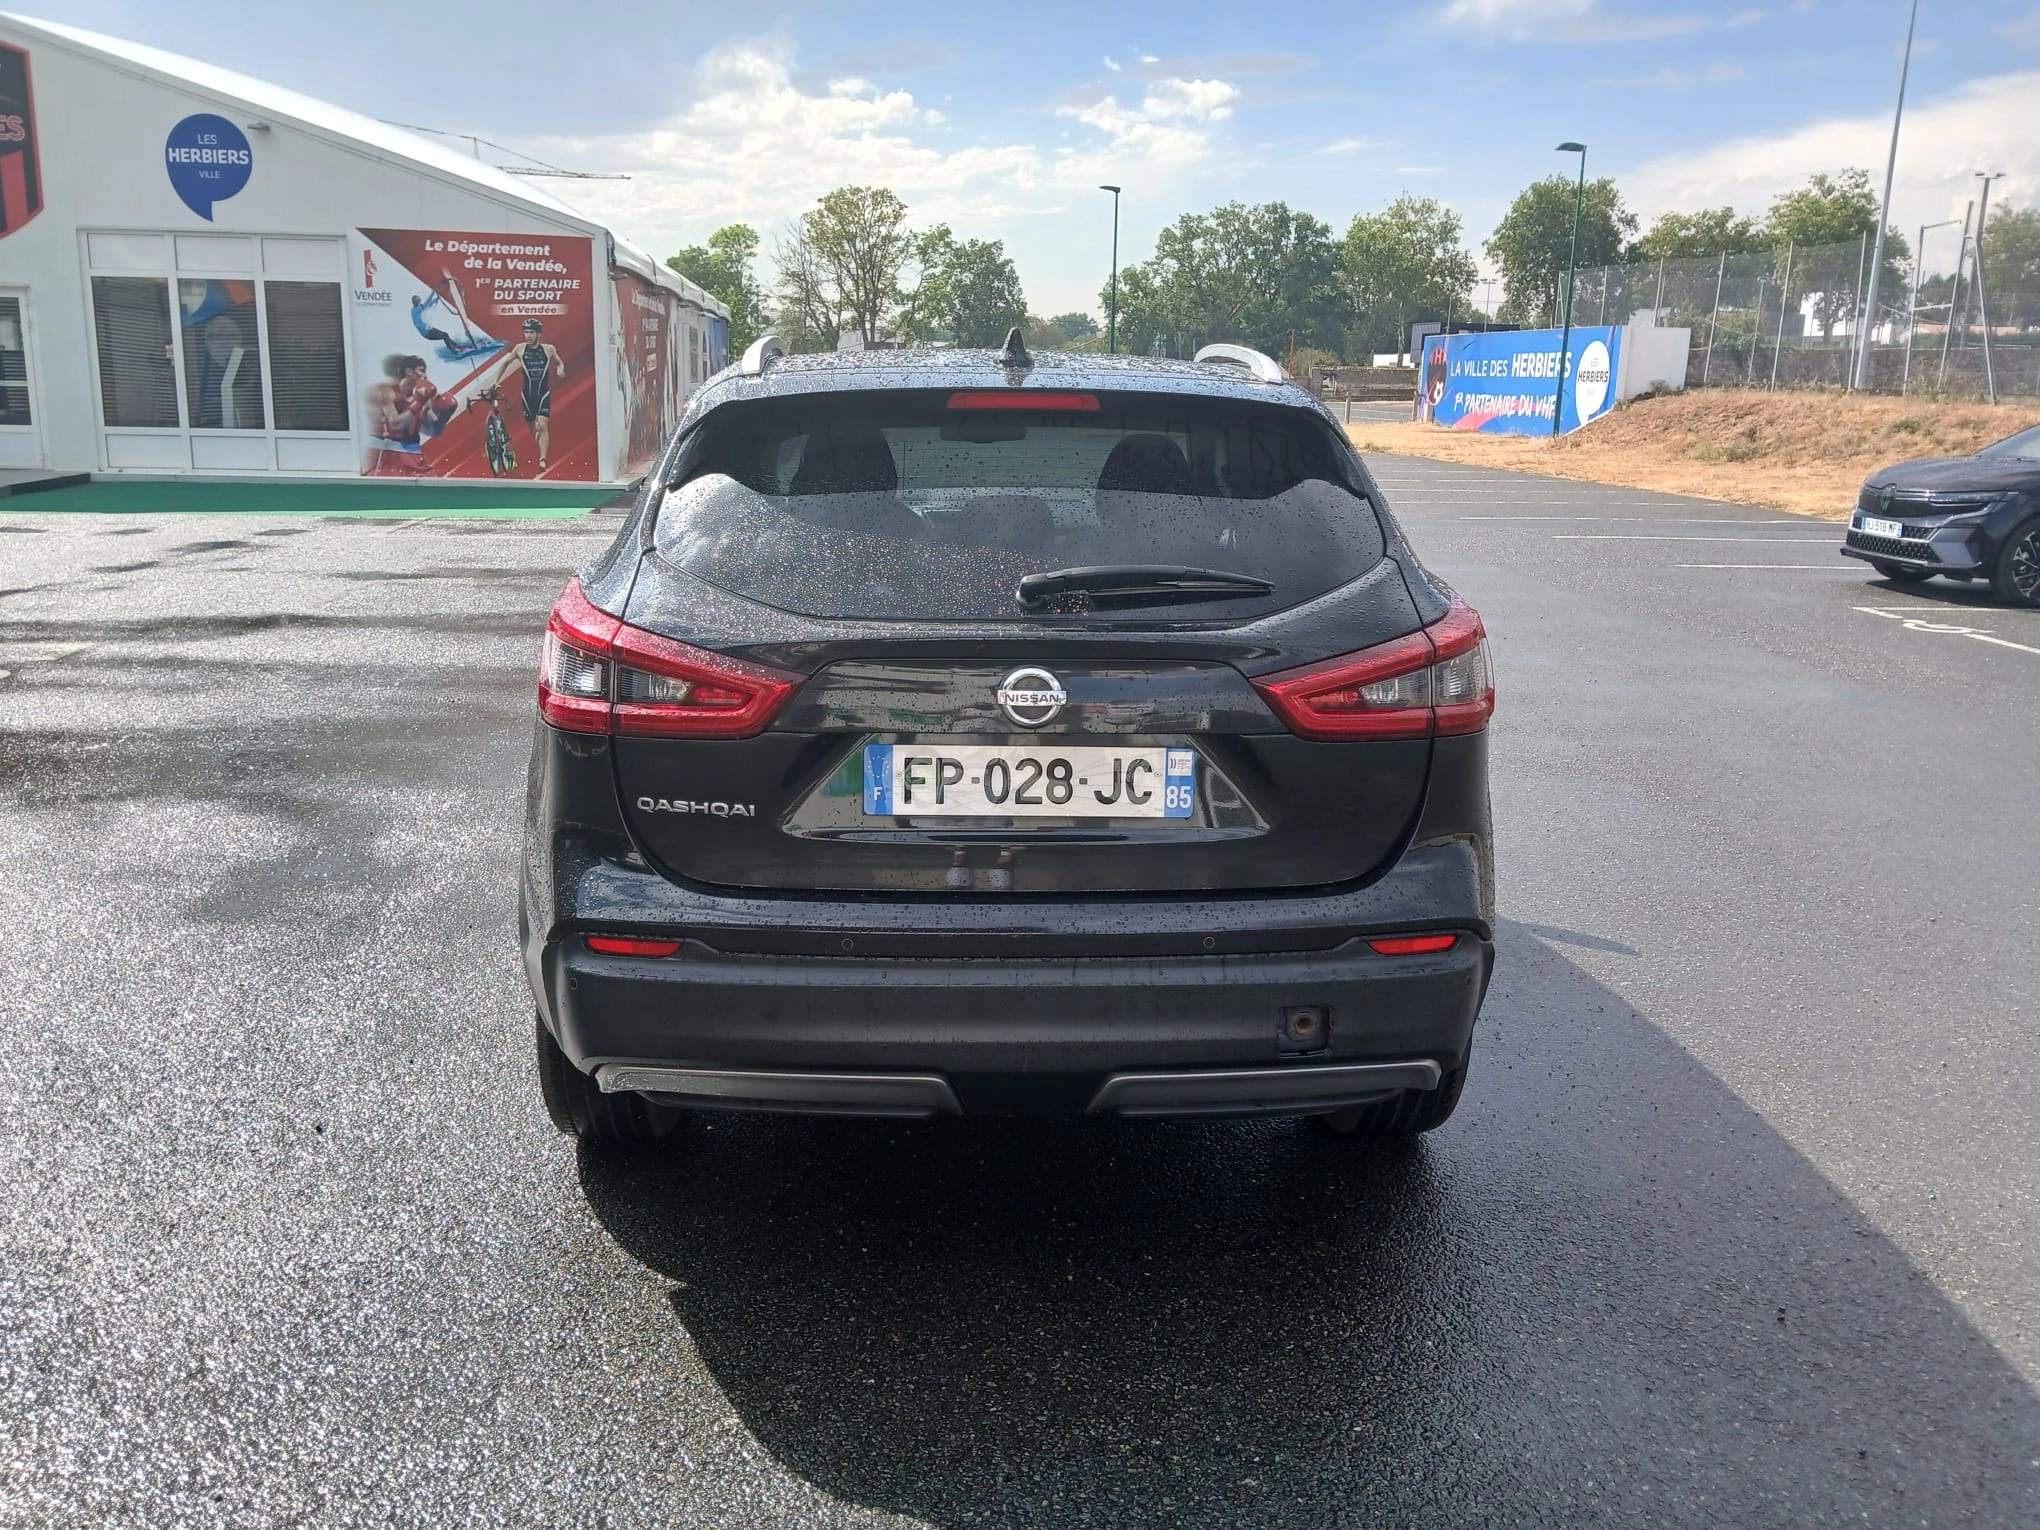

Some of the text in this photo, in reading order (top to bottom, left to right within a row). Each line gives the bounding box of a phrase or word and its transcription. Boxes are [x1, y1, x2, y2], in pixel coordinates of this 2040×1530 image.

[197, 134, 217, 145] LES
[168, 147, 249, 165] HERBIERS
[199, 170, 221, 179] VILLE
[425, 239, 551, 256] Le Département
[464, 257, 567, 274] de la Vendée,
[494, 278, 580, 289] PARTENAIRE
[494, 291, 563, 300] DU SPORT
[517, 305, 557, 314] Vendée
[1450, 361, 1461, 376] LA
[1464, 360, 1487, 376] VILLE
[1489, 359, 1508, 376] DES
[1578, 371, 1608, 382] HERBIERS
[1464, 392, 1517, 418] PARTENAIRE
[1517, 394, 1533, 418] DU
[1005, 694, 1059, 703] NISSAN
[904, 757, 1153, 805] FP-028-JC
[873, 787, 881, 801] F
[1166, 785, 1192, 809] 85
[637, 797, 755, 818] QASHQAI
